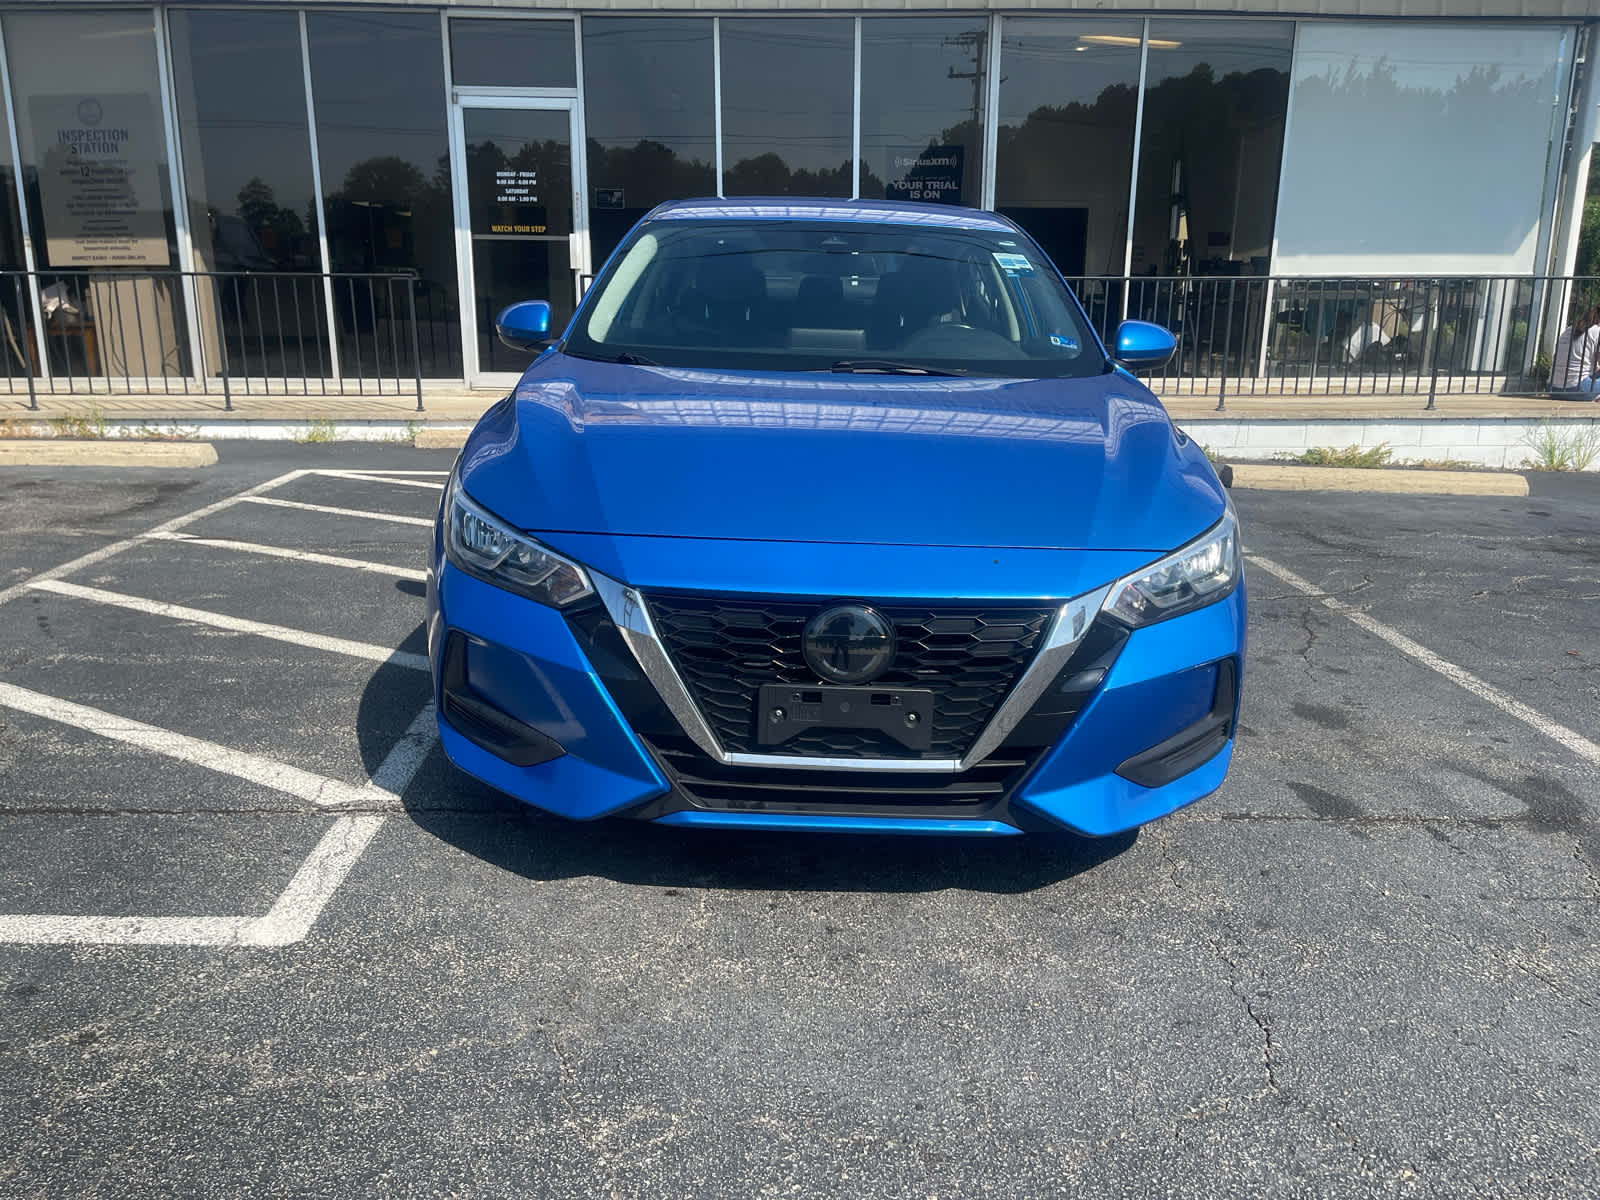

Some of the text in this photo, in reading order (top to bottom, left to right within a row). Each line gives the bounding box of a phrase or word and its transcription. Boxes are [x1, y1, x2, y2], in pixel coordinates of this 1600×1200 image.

[57, 127, 128, 142] INSPECTION
[72, 142, 119, 154] STATION
[81, 166, 90, 176] 12
[894, 181, 959, 190] YOUR TRIAL
[910, 190, 941, 199] IS ON
[491, 224, 546, 233] WATCH YOUR STEP
